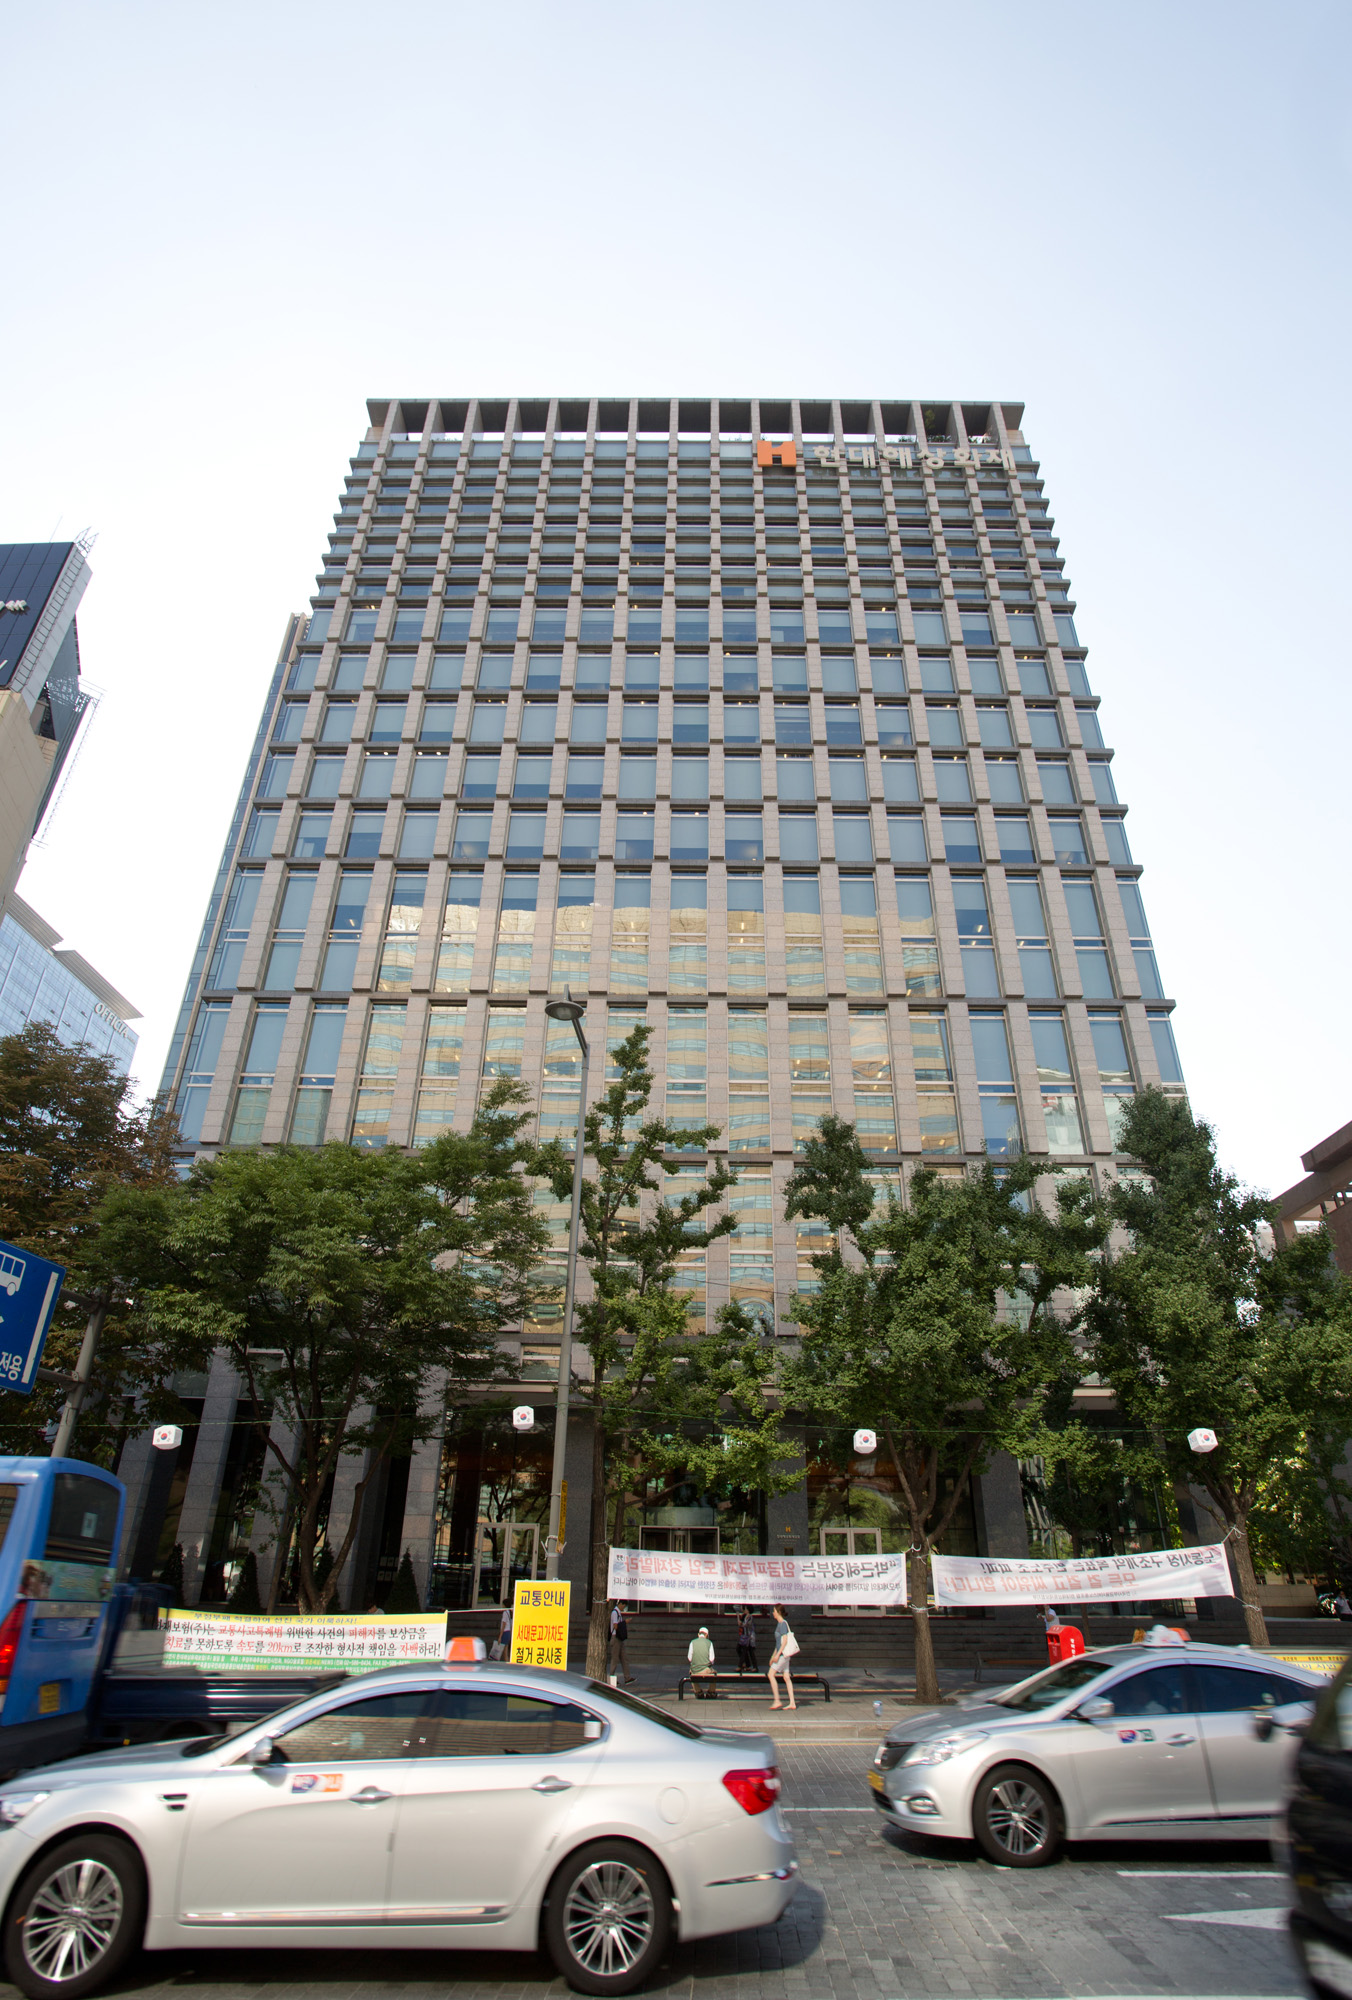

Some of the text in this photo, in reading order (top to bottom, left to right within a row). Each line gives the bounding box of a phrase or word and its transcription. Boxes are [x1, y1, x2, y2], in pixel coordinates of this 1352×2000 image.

[813, 445, 1017, 471] 현대해상화재
[94, 1002, 129, 1038] OFFICIA
[520, 1590, 565, 1606] 교통안내
[218, 1624, 283, 1638] 교통사고특례법
[286, 1626, 315, 1639] 위반한
[318, 1627, 345, 1640] 사건의
[348, 1627, 386, 1640] 피해자를
[389, 1627, 427, 1640] 보상금을
[517, 1624, 564, 1642] 서대문고가차도
[196, 1638, 234, 1652] 못하도록
[236, 1641, 265, 1653] 속도를
[267, 1642, 302, 1654] 20km로
[304, 1642, 335, 1655] 조작한
[337, 1643, 365, 1655] 형사적
[368, 1643, 397, 1656] 책임을
[399, 1643, 441, 1657] 자백하라!
[516, 1647, 562, 1665] 철거 공사중
